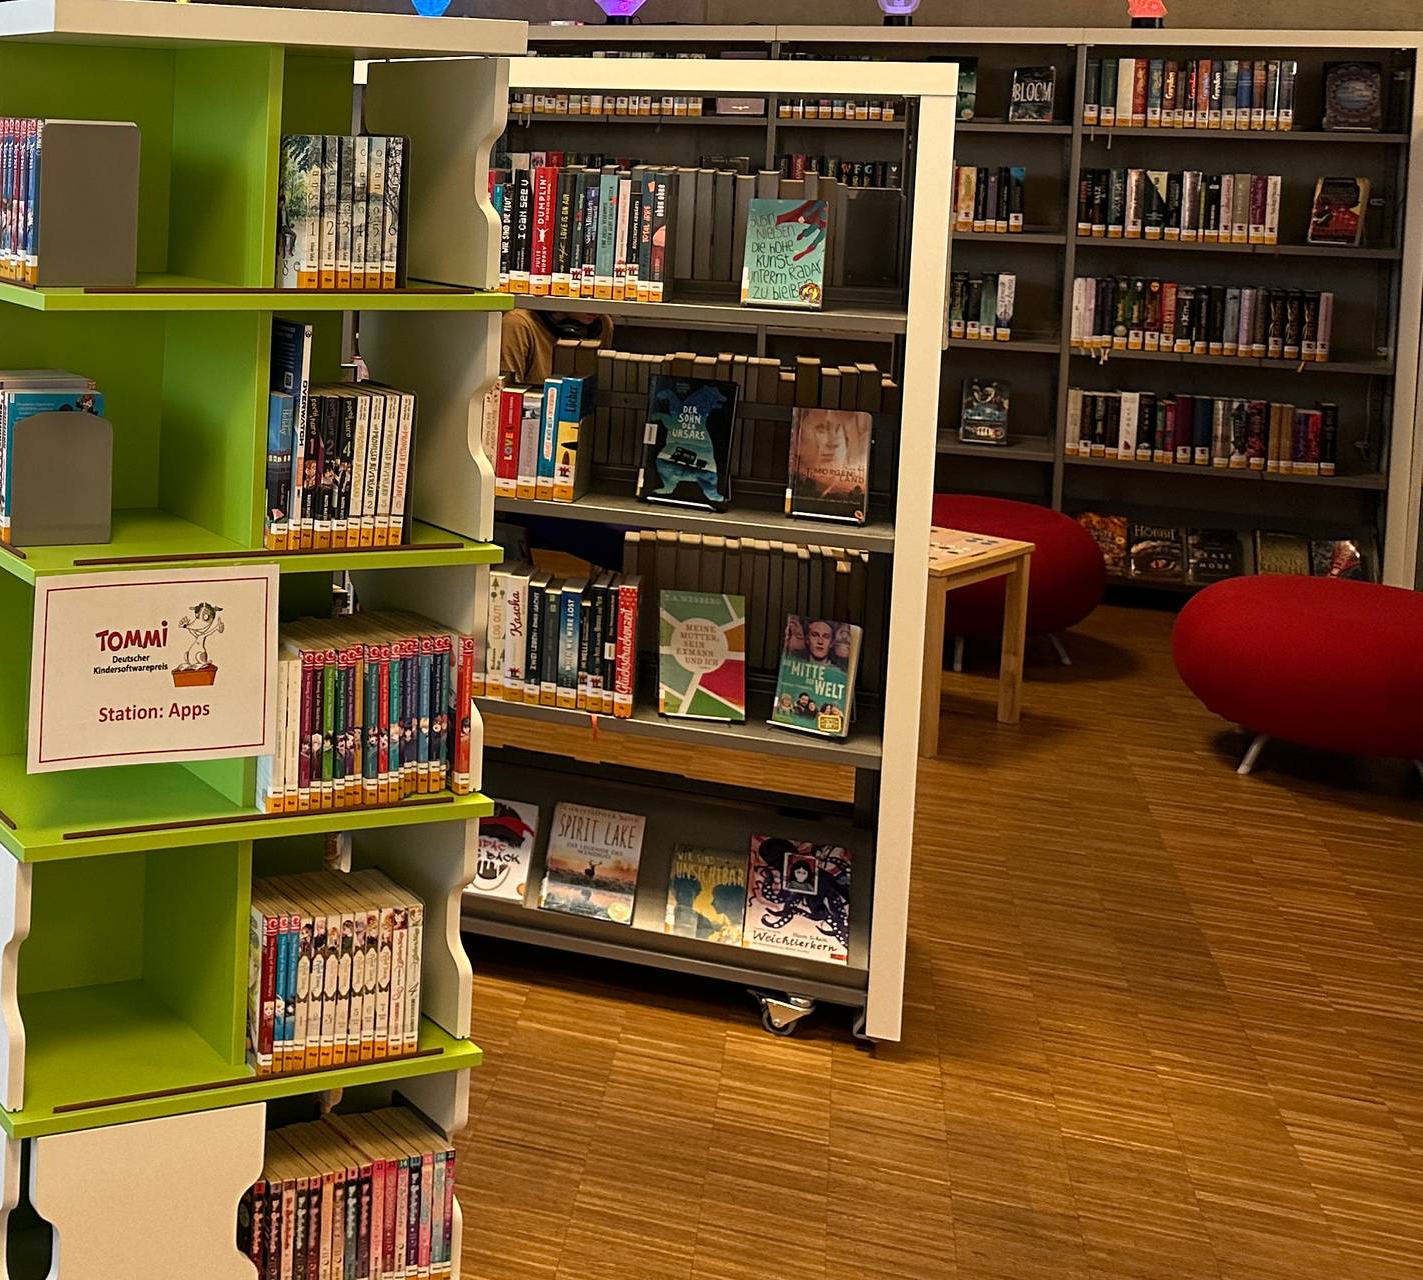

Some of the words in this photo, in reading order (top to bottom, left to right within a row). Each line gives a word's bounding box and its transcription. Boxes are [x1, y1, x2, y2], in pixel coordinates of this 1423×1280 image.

[1013, 82, 1053, 102] BLOOM
[537, 175, 547, 225] DUMPLIN'
[310, 221, 316, 236] 1
[326, 220, 334, 236] 2
[342, 221, 350, 235] 3
[356, 223, 364, 237] 4
[372, 223, 379, 237] 5
[388, 221, 397, 236] 6
[560, 224, 568, 240] LOVE
[299, 380, 309, 447] OVERWATCH
[677, 412, 702, 425] SOHN
[503, 431, 514, 461] LOVE
[567, 599, 575, 617] LOST
[566, 619, 574, 637] WERE
[112, 653, 150, 664] Deutscher
[93, 663, 168, 675] Kindersoftwarepreis
[790, 661, 825, 680] MITTE
[814, 679, 845, 700] WELT
[98, 704, 163, 723] Station:
[169, 702, 210, 720] Apps
[557, 813, 599, 844] SPIRIT
[604, 821, 637, 849] LAKE
[485, 851, 521, 865] BACK
[752, 930, 838, 952] Weichtierkern
